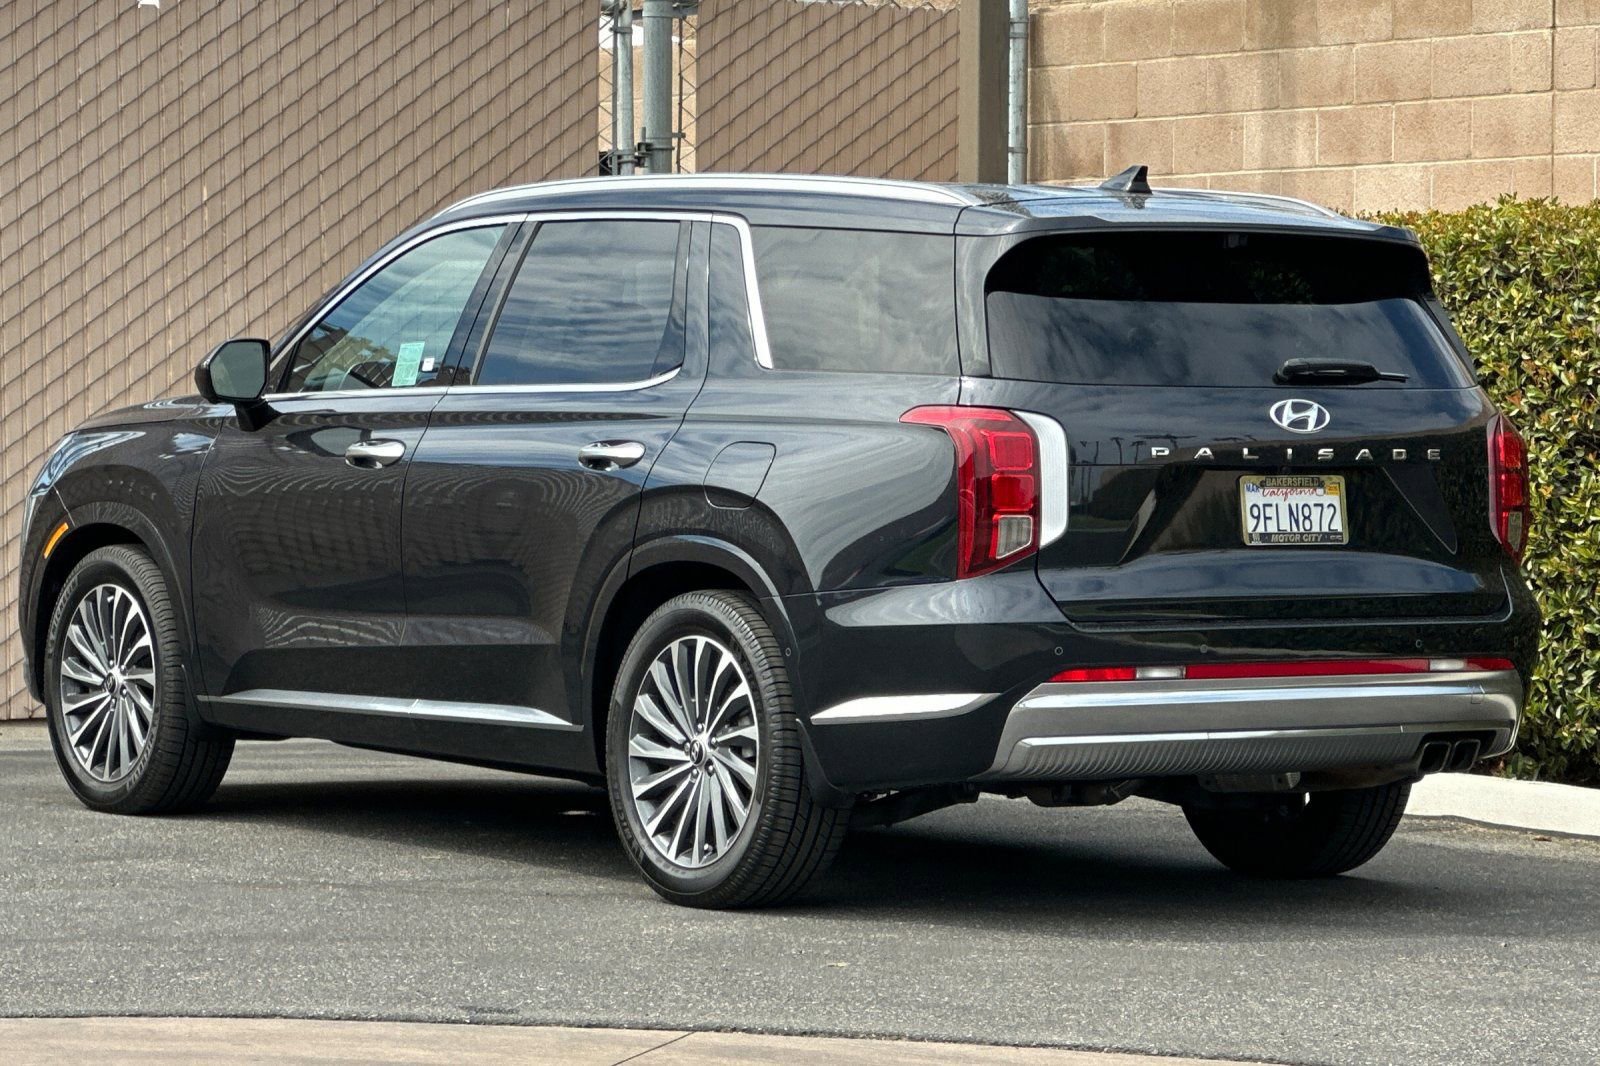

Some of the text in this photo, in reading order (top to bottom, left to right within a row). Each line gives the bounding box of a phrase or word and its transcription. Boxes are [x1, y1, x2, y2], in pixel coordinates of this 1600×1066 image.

[1151, 447, 1441, 461] PALISADE
[1265, 477, 1319, 487] BAKERSFIELD
[1262, 486, 1317, 502] California
[1249, 503, 1338, 532] 9FLN872
[1271, 533, 1301, 542] MOTOR
[1302, 533, 1322, 542] CITY
